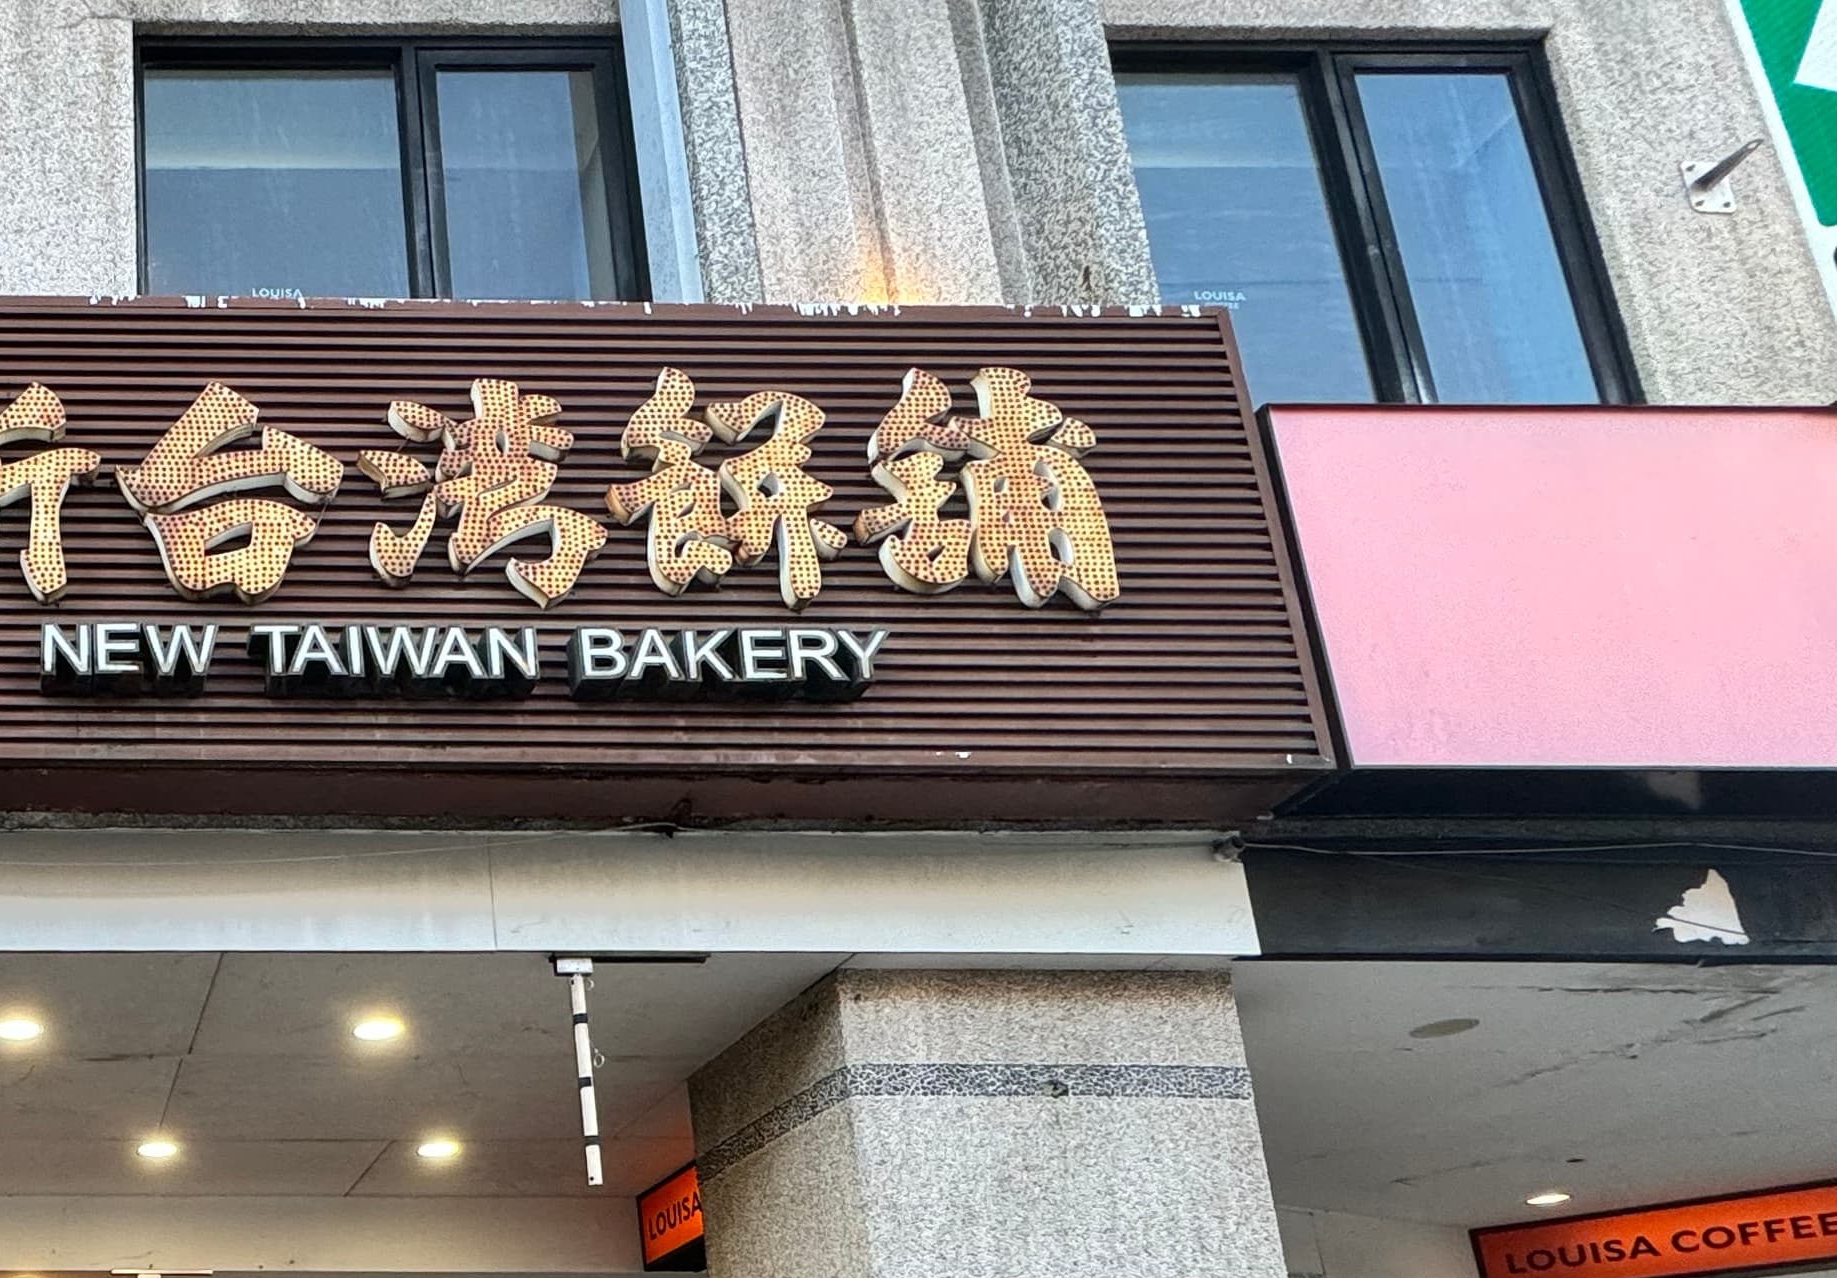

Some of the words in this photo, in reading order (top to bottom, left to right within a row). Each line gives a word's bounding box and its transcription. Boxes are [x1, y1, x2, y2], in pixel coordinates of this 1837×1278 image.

[252, 287, 303, 299] LOUISA
[1194, 290, 1246, 302] LOUISA
[41, 622, 219, 678] NEW
[253, 623, 539, 679] TAIWAN
[581, 625, 890, 682] BAKERY
[647, 1191, 703, 1241] LOUISA
[1506, 1235, 1662, 1274] LOUISA
[1671, 1211, 1837, 1253] COFFEE
